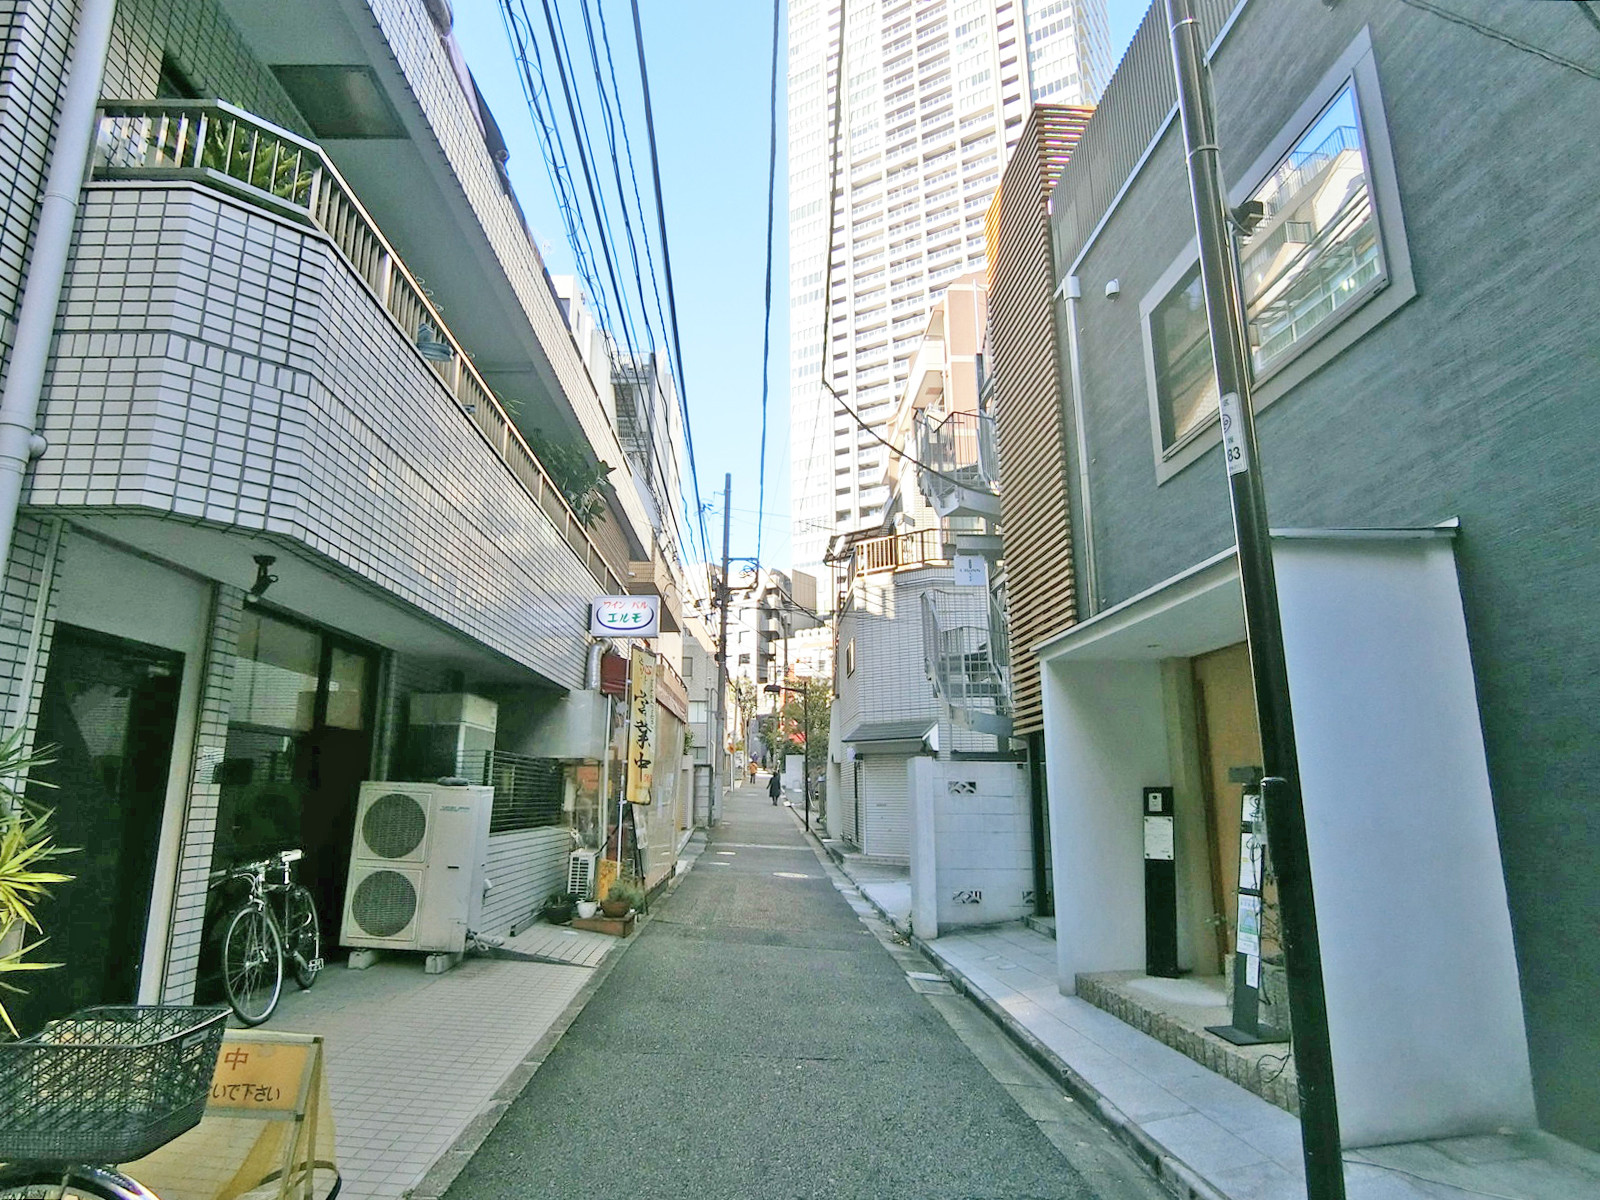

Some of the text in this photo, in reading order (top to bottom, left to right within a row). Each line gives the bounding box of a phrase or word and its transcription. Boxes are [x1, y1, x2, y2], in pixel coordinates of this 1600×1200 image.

[1227, 446, 1240, 462] 83
[604, 601, 626, 609] ワイン
[607, 612, 643, 623] エルモ
[633, 689, 652, 782] 営業中
[224, 1047, 249, 1071] 中
[212, 1083, 280, 1102] いで下さい
